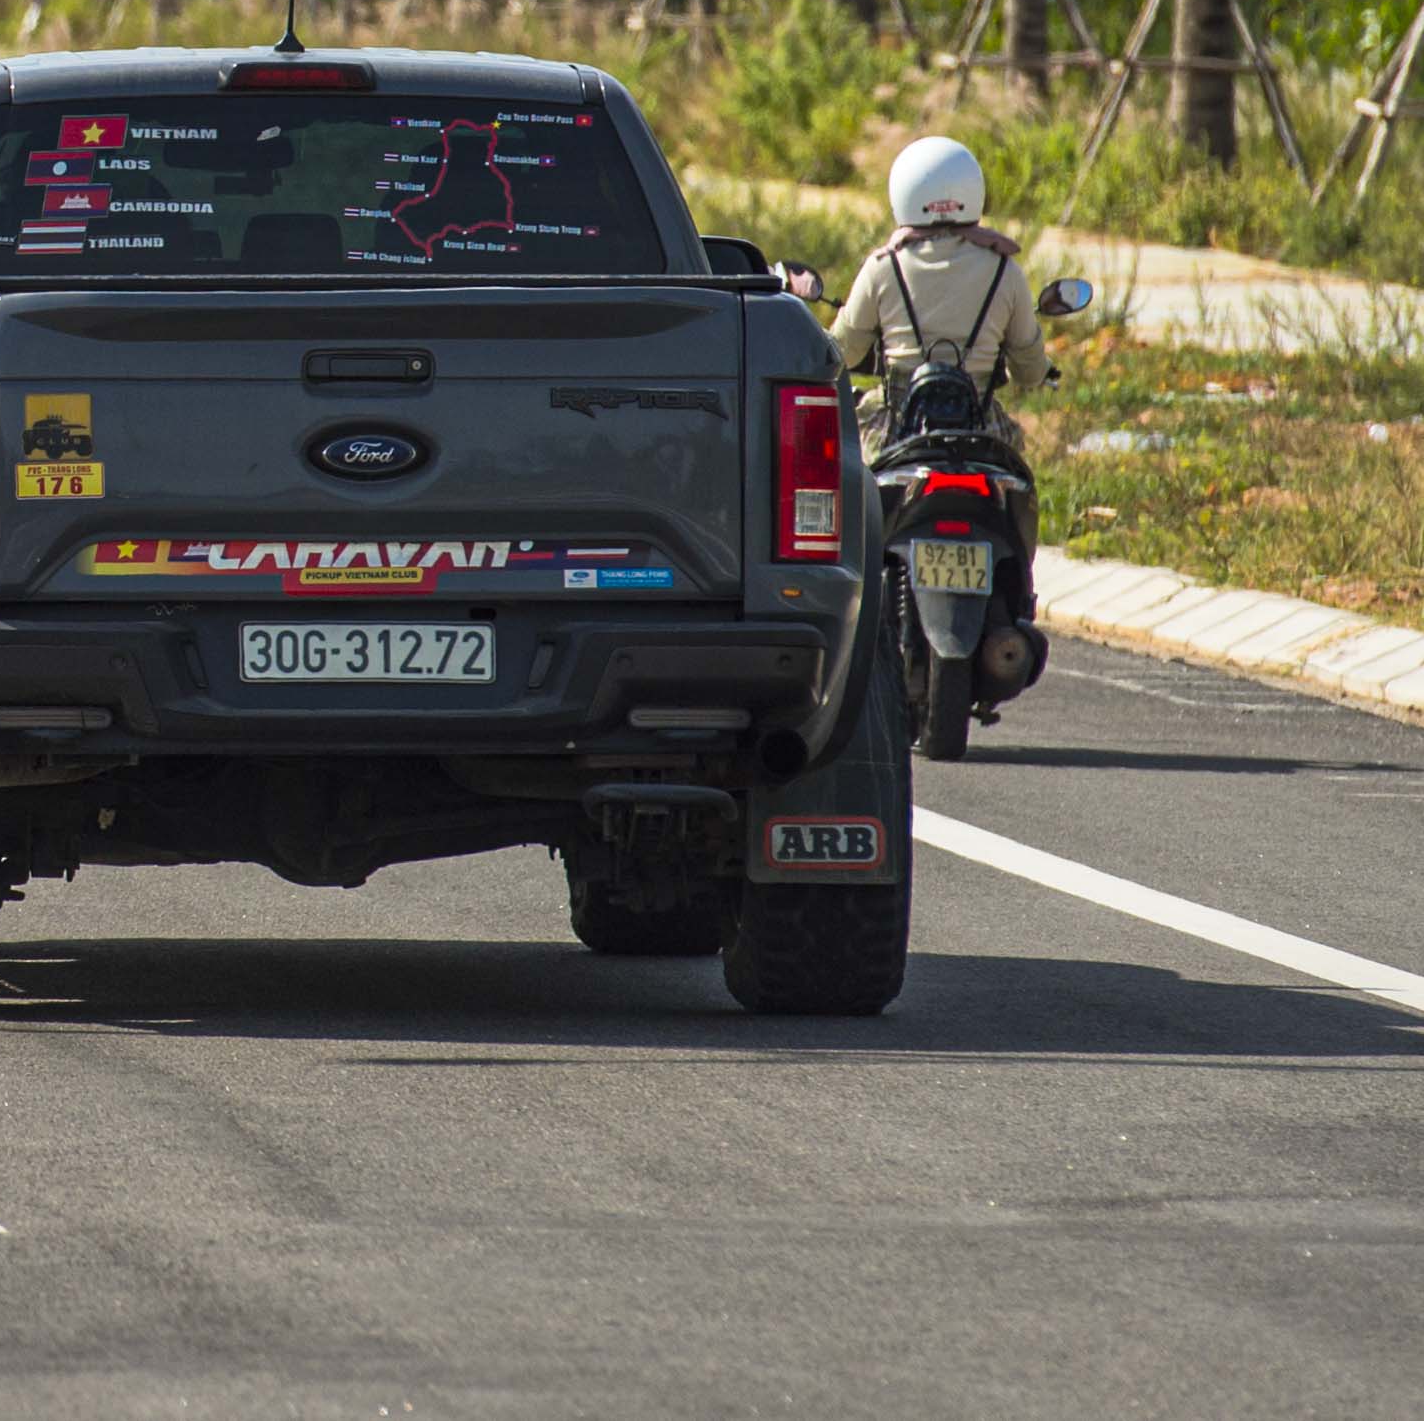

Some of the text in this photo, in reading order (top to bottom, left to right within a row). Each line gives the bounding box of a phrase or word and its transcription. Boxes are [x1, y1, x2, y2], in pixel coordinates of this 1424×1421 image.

[130, 127, 218, 140] VIETNAM
[98, 159, 152, 171] LAOS
[109, 200, 214, 214] CAMBODIA
[88, 236, 164, 249] THAILAND
[550, 386, 729, 421] RAPTOR
[343, 440, 394, 466] Ford
[305, 569, 418, 580] PICKUP VIETNAM CLUB
[248, 629, 487, 675] 30G-312.72
[776, 826, 875, 860] ARB
